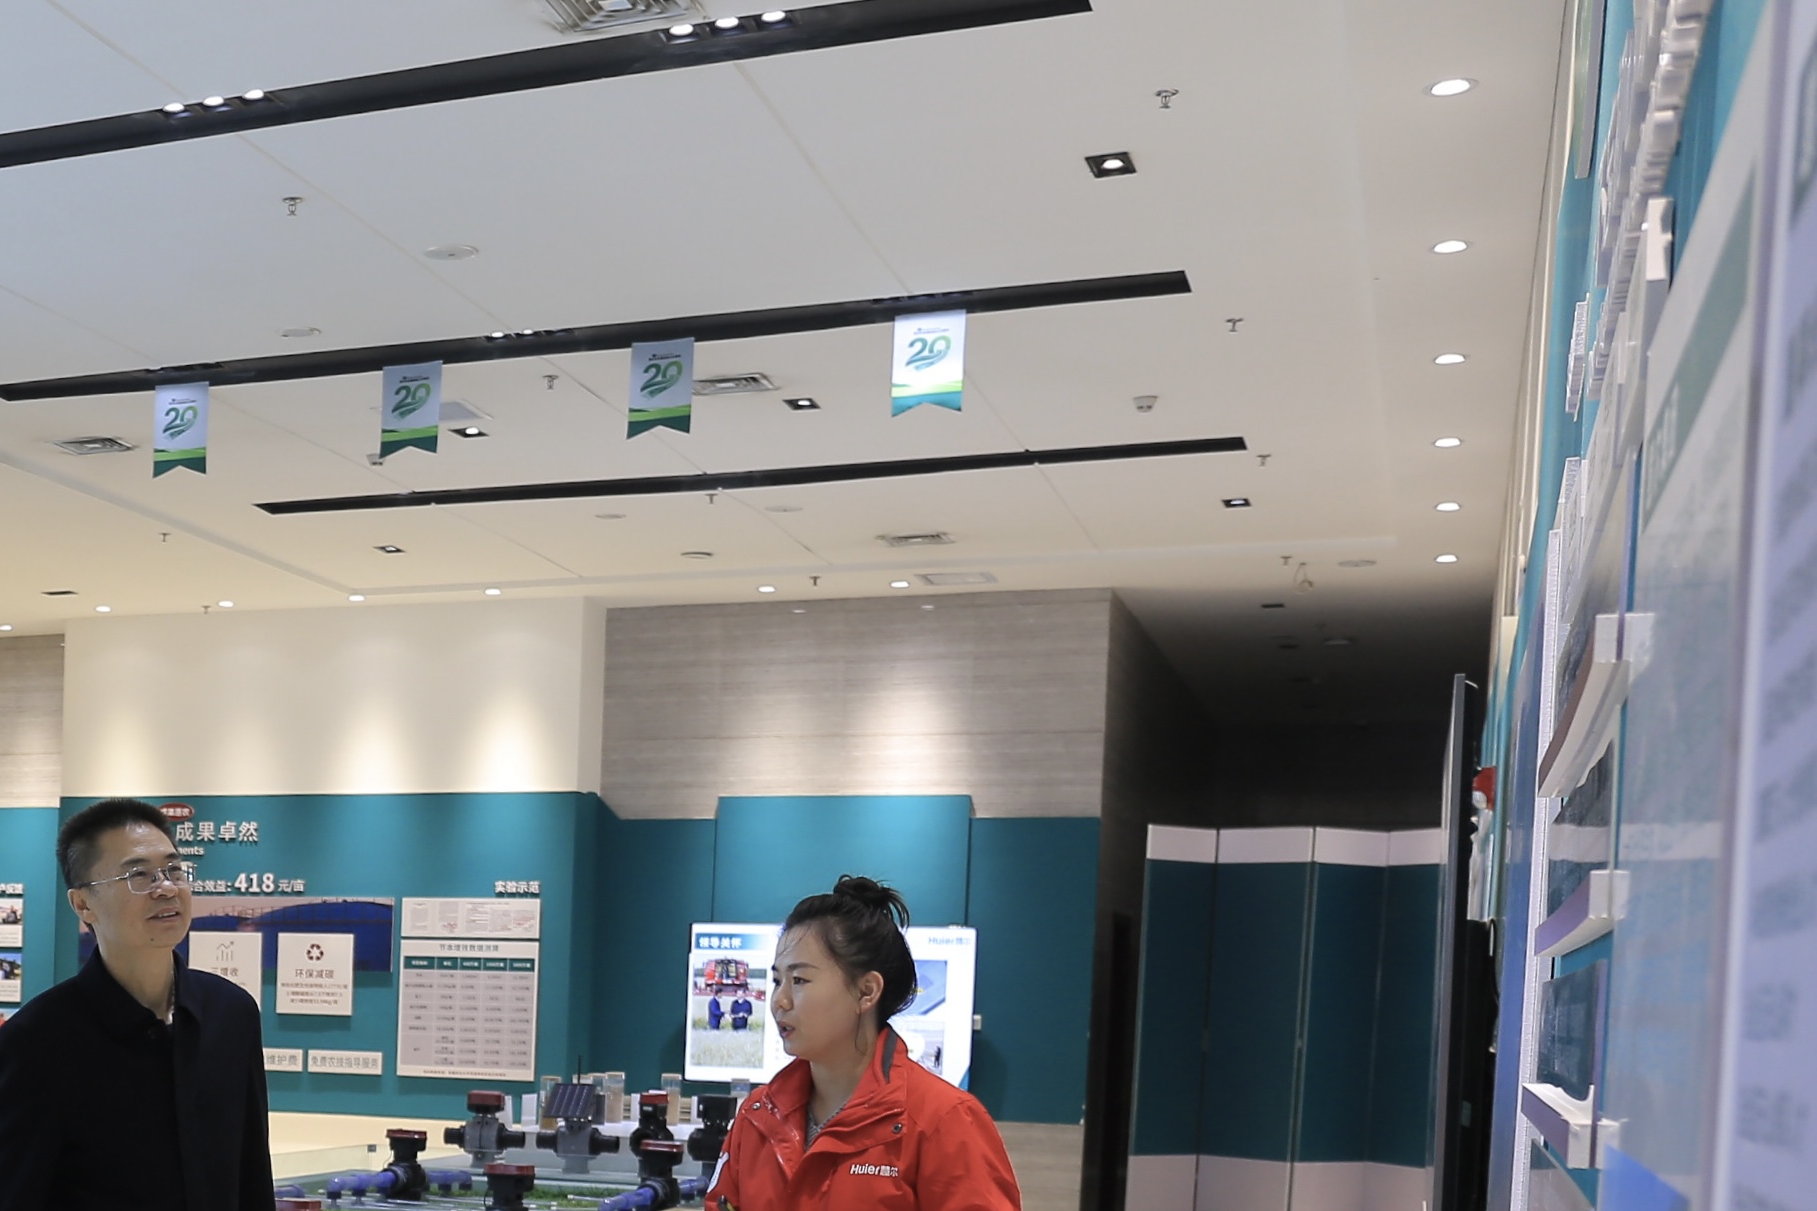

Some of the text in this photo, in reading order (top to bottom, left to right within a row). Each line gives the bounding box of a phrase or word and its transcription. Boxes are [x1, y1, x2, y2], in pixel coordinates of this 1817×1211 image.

[175, 821, 259, 842] 成果卓然
[234, 873, 275, 893] 418
[278, 880, 305, 892] 元/亩
[310, 1055, 378, 1070] 免费农技指导服务
